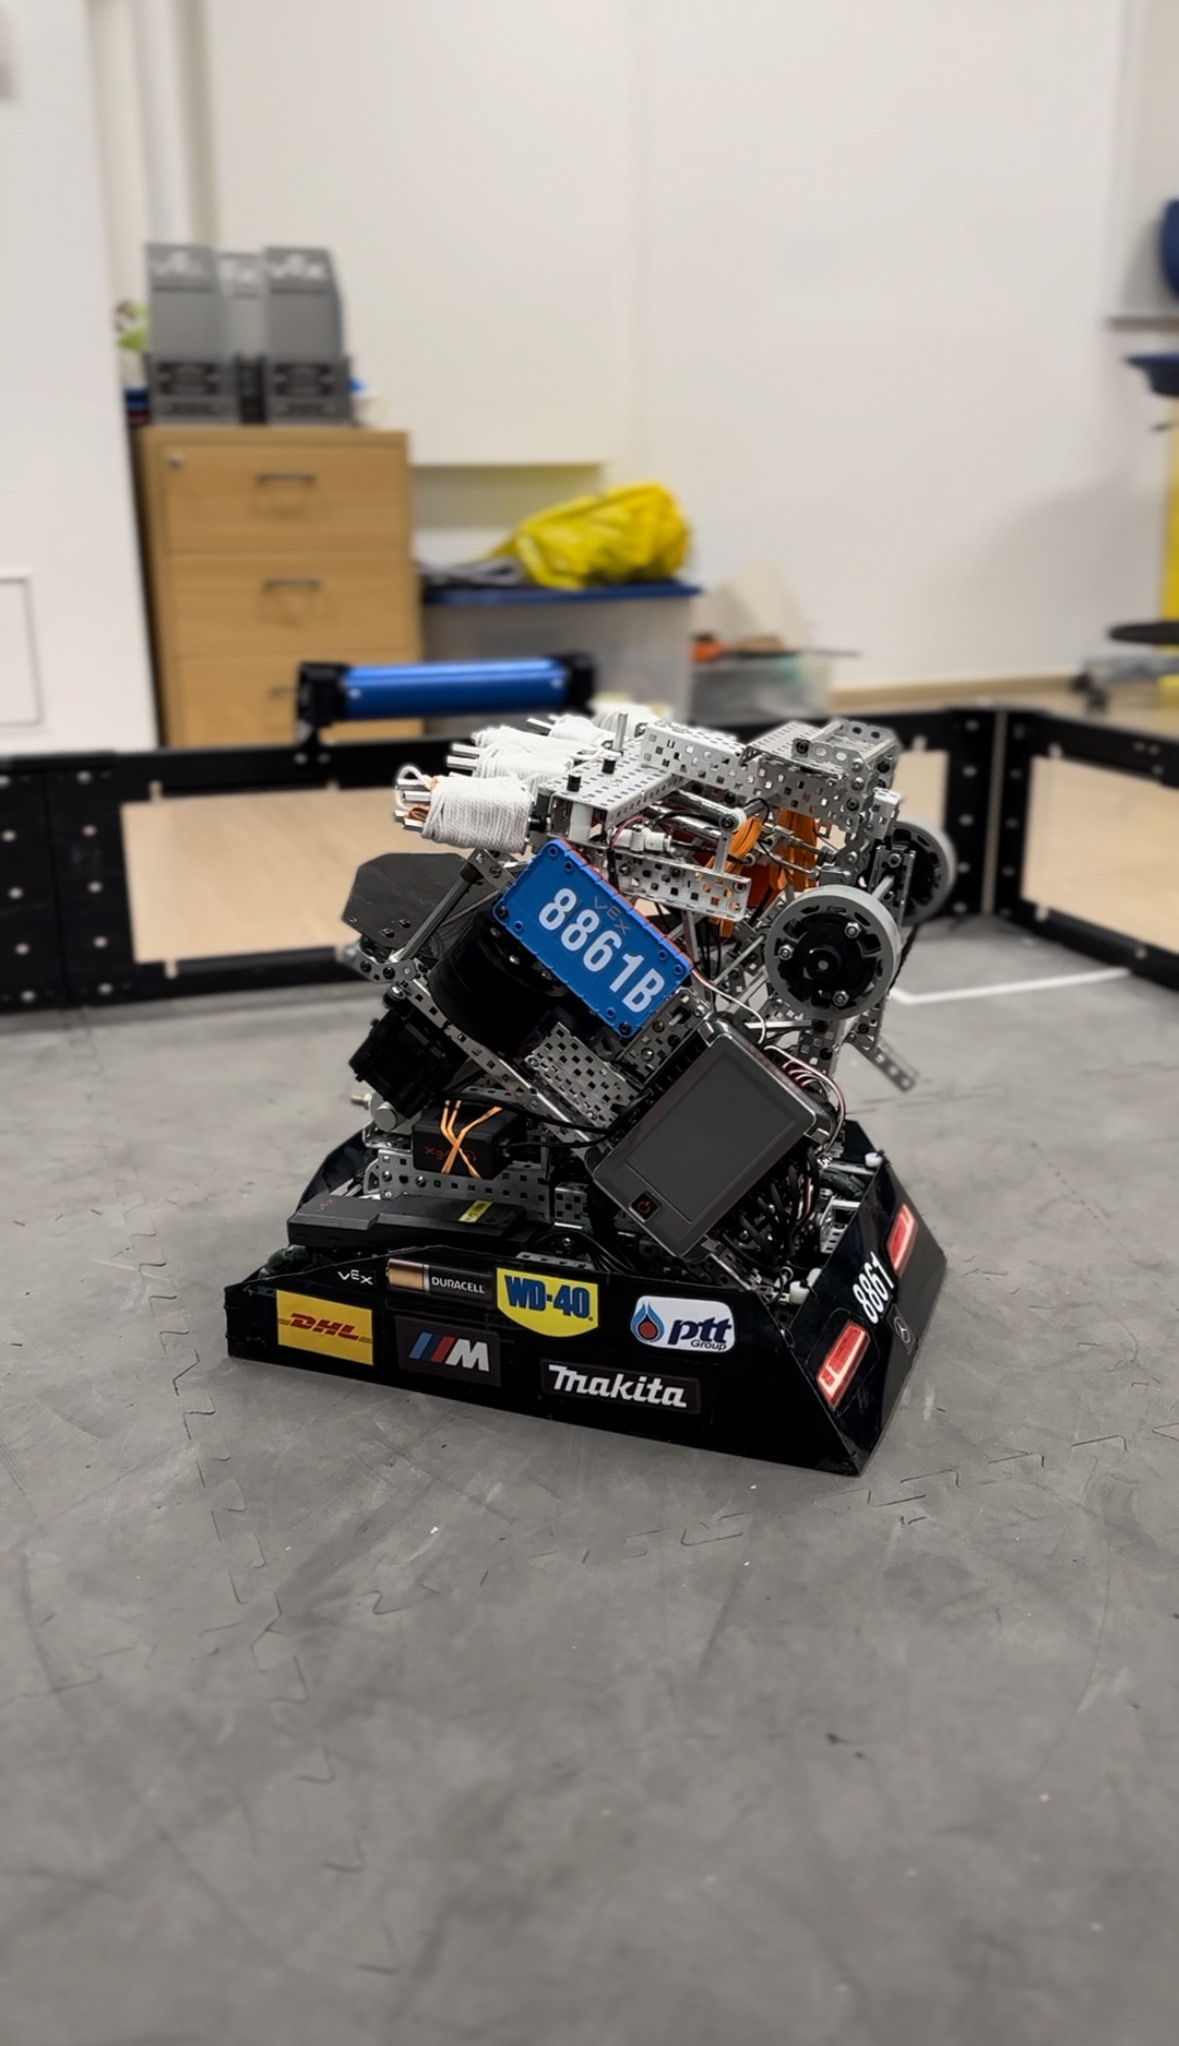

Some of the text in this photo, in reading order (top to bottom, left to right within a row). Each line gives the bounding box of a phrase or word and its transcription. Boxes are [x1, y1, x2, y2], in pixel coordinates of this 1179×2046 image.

[594, 895, 631, 936] VEX
[539, 888, 665, 1013] 8861B
[338, 1269, 373, 1286] VEX
[431, 1276, 486, 1294] DURACELL
[853, 1251, 894, 1324] 8861
[504, 1275, 590, 1319] WD-40
[290, 1312, 360, 1341] DHL
[667, 1317, 732, 1345] ptt
[690, 1338, 727, 1351] Group
